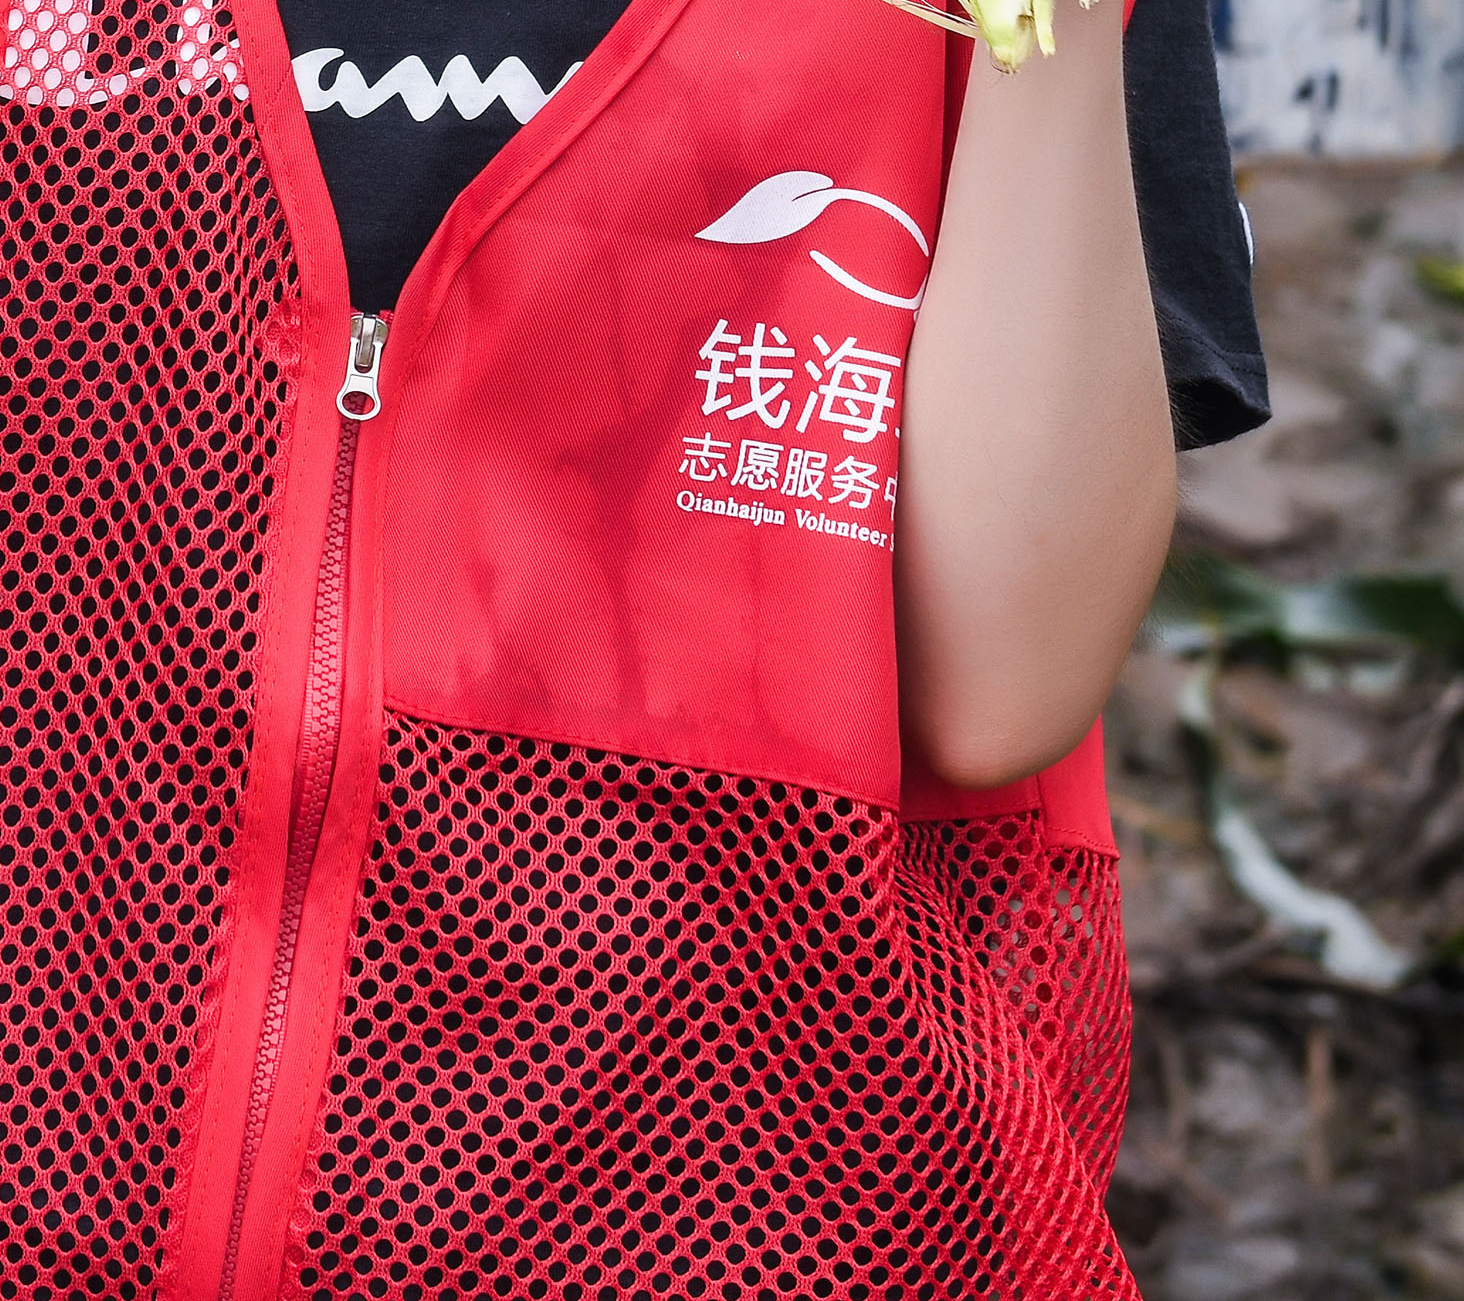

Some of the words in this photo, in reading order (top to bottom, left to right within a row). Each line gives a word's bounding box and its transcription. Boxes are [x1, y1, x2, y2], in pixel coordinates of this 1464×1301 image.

[694, 318, 902, 444] 钱海
[675, 489, 786, 527] Qianhaijun
[794, 508, 888, 548] Volunteer
